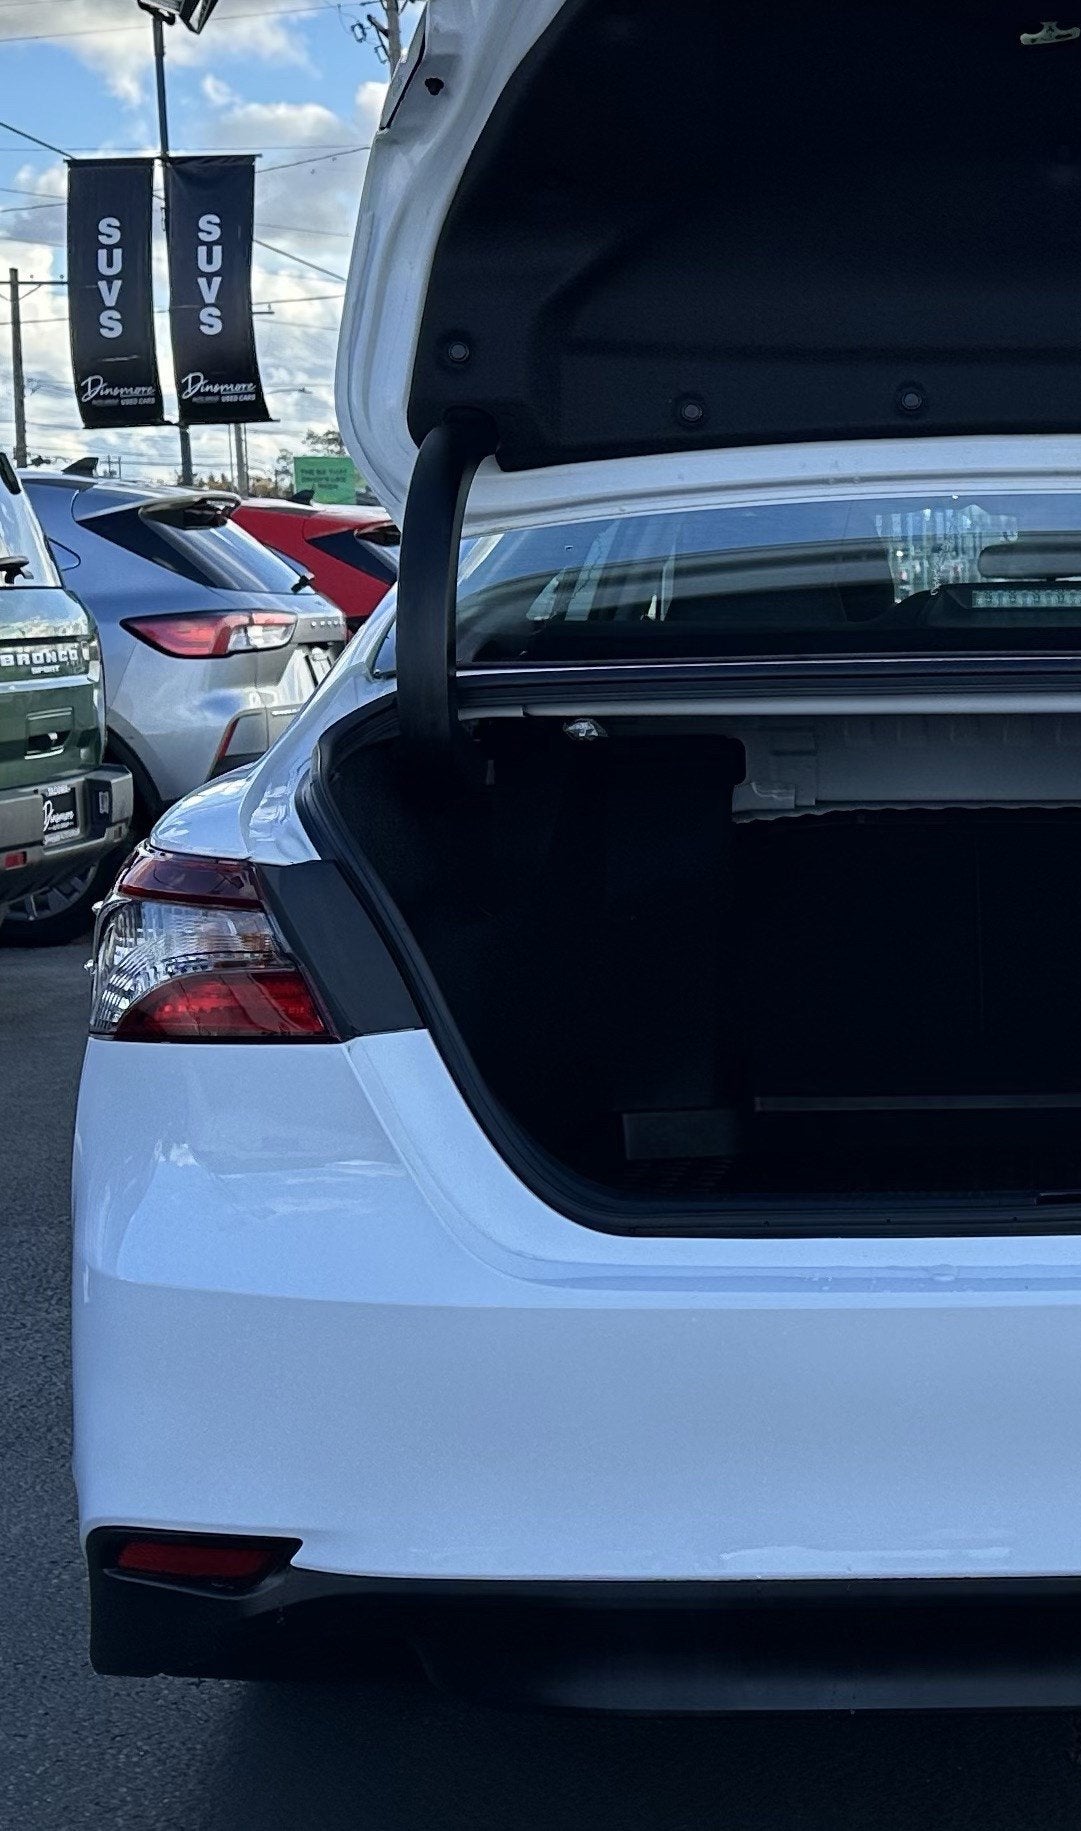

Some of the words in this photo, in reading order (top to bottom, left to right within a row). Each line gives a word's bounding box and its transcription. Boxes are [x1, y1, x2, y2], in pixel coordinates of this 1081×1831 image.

[97, 216, 123, 339] SUVS
[197, 213, 223, 335] SUVS
[81, 375, 155, 402] Dinsmore
[181, 372, 256, 399] Dinsmore
[0, 649, 79, 666] BRONCO
